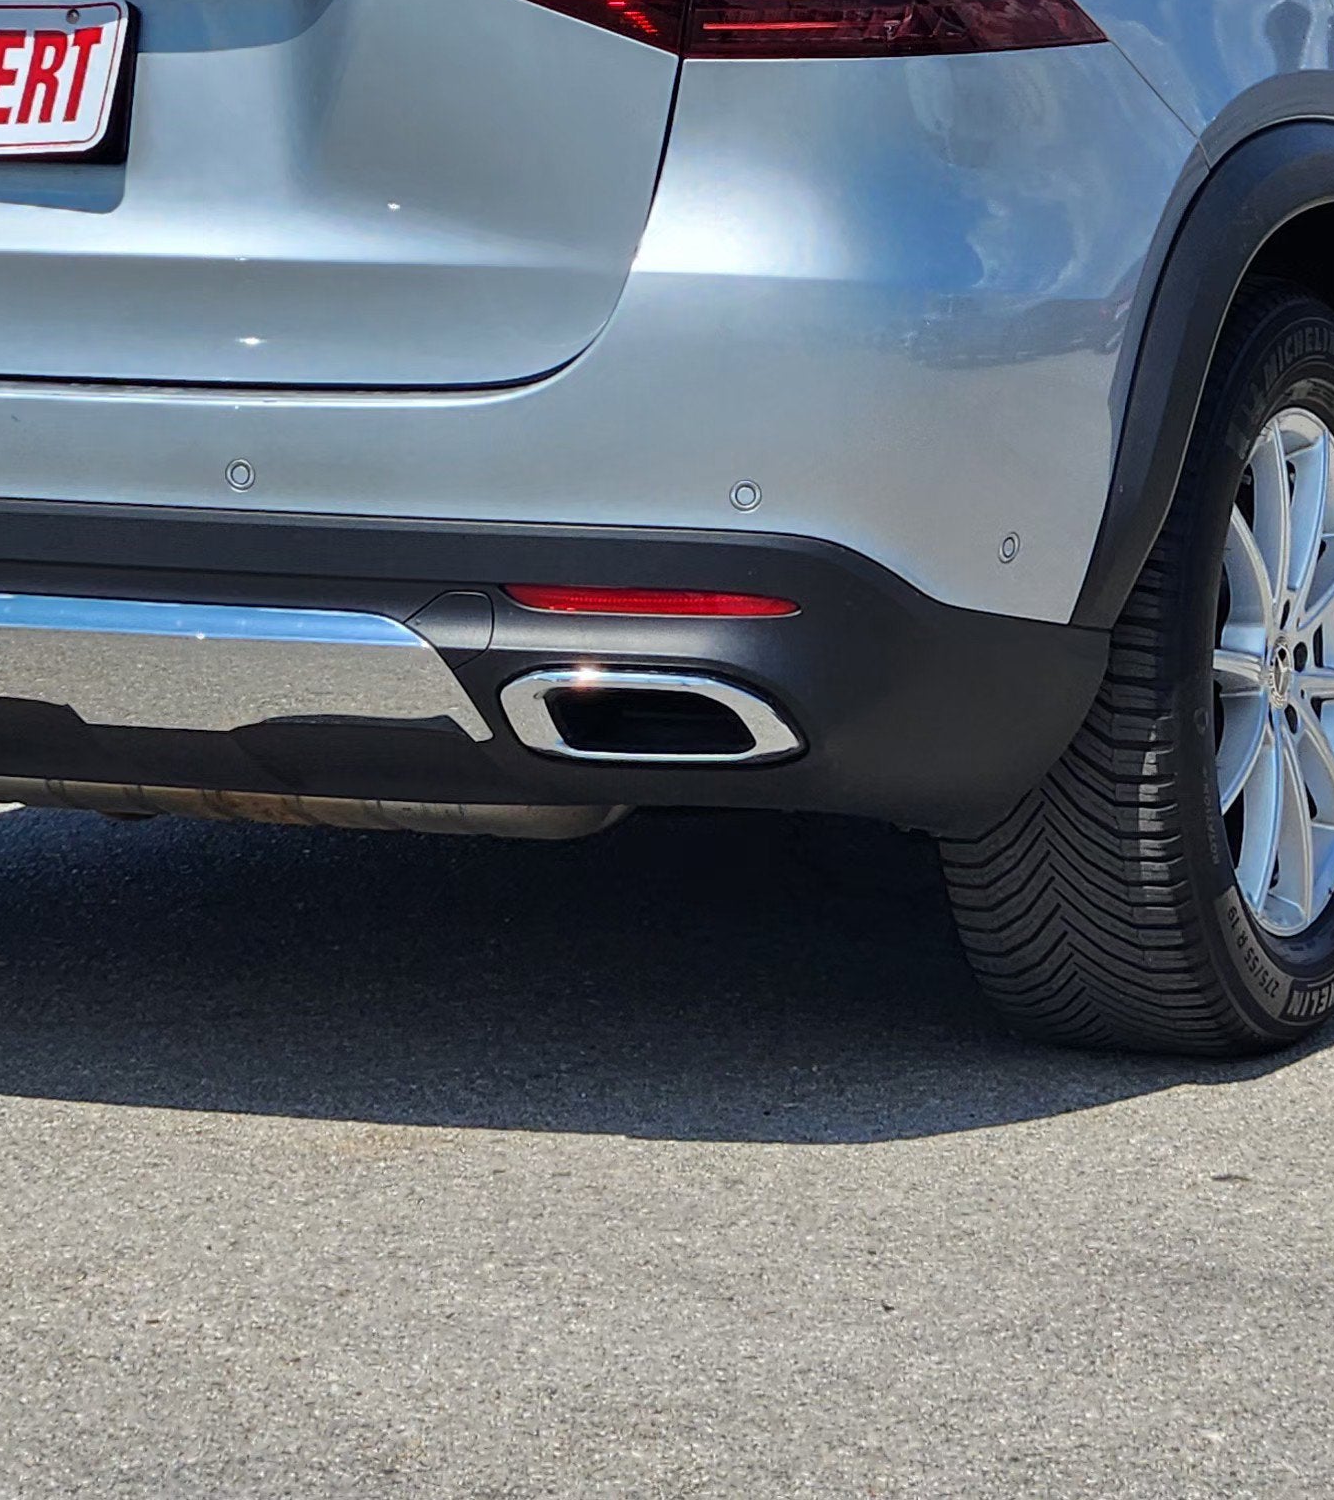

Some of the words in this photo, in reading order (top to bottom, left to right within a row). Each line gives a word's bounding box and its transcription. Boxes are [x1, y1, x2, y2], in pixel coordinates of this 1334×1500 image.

[1203, 783, 1220, 865] ROTATION
[1226, 905, 1240, 928] 19
[1236, 930, 1248, 948] R
[1244, 947, 1280, 998] 275/55
